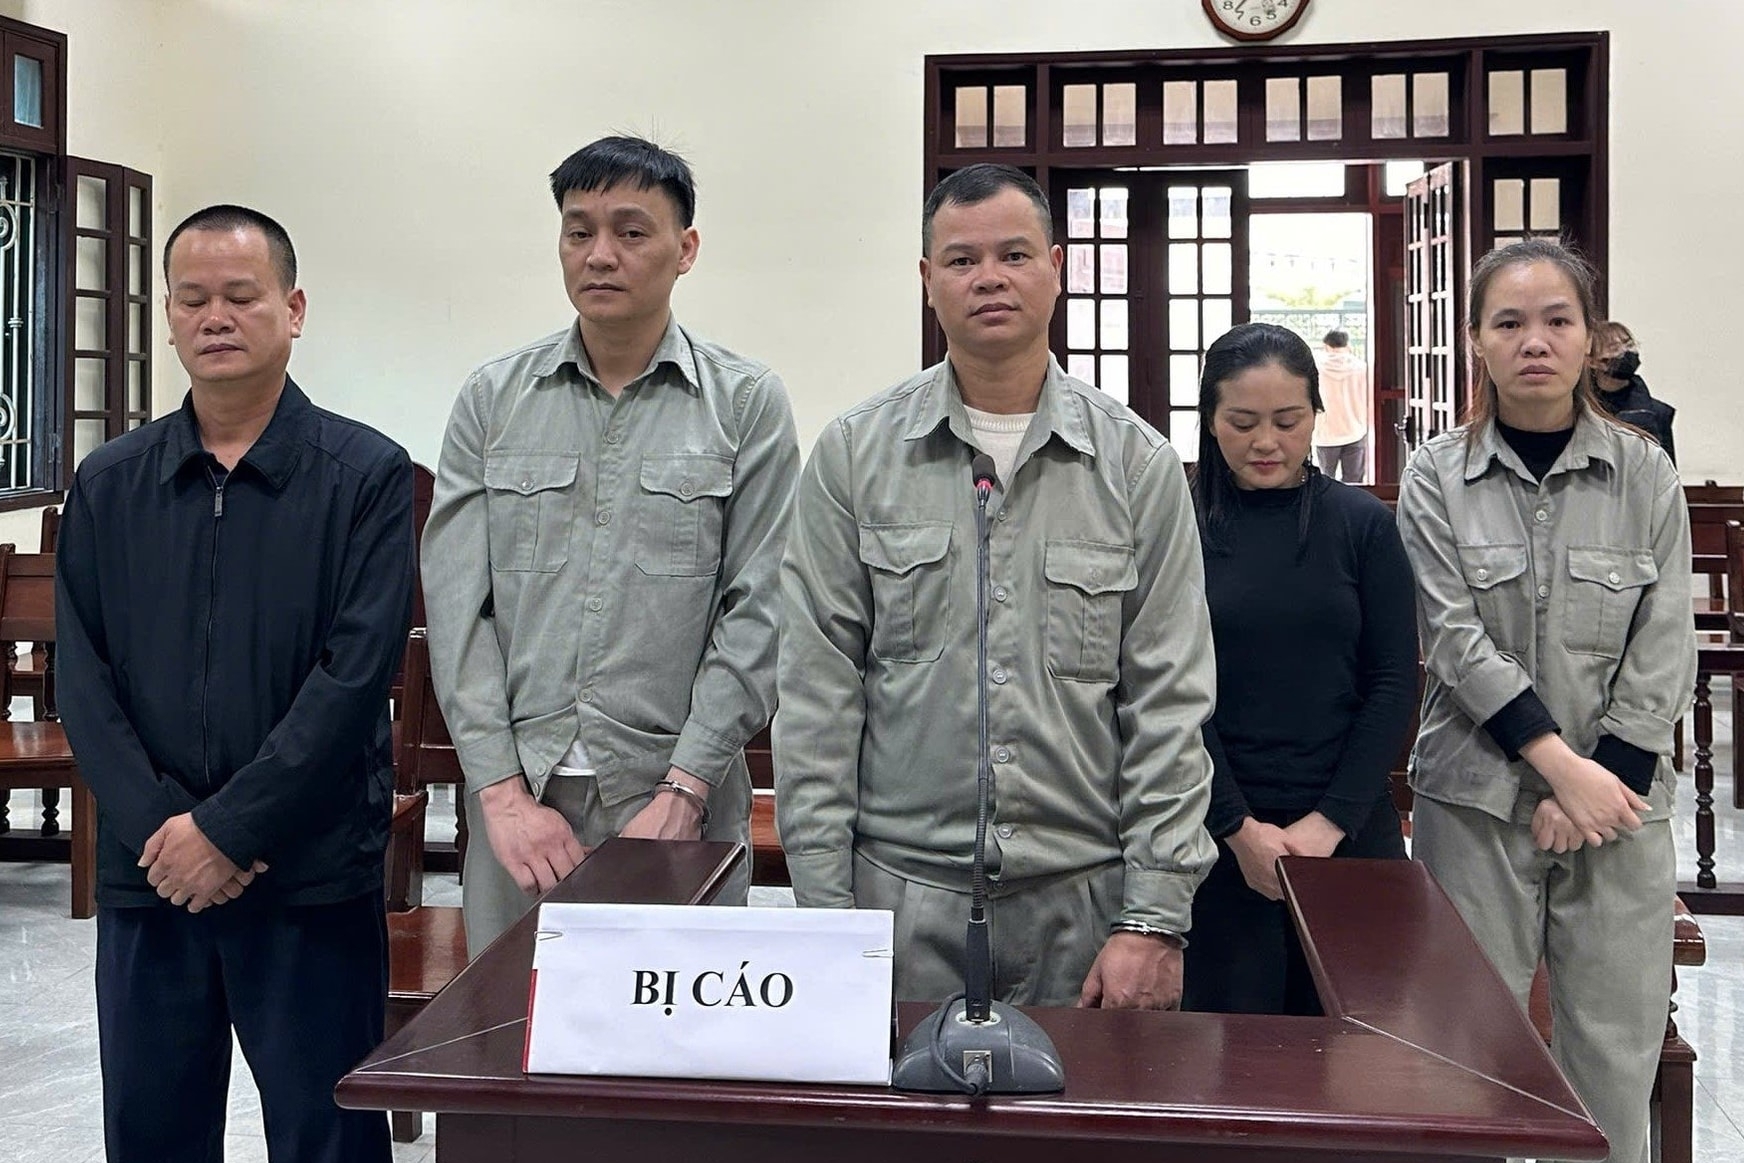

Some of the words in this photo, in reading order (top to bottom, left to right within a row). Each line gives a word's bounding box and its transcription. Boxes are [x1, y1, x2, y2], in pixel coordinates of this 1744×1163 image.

[1223, 0, 1234, 10] 8
[1266, 10, 1277, 20] 5
[1250, 16, 1262, 26] 6
[631, 970, 680, 1016] BỊ
[692, 960, 793, 1008] CÁO
